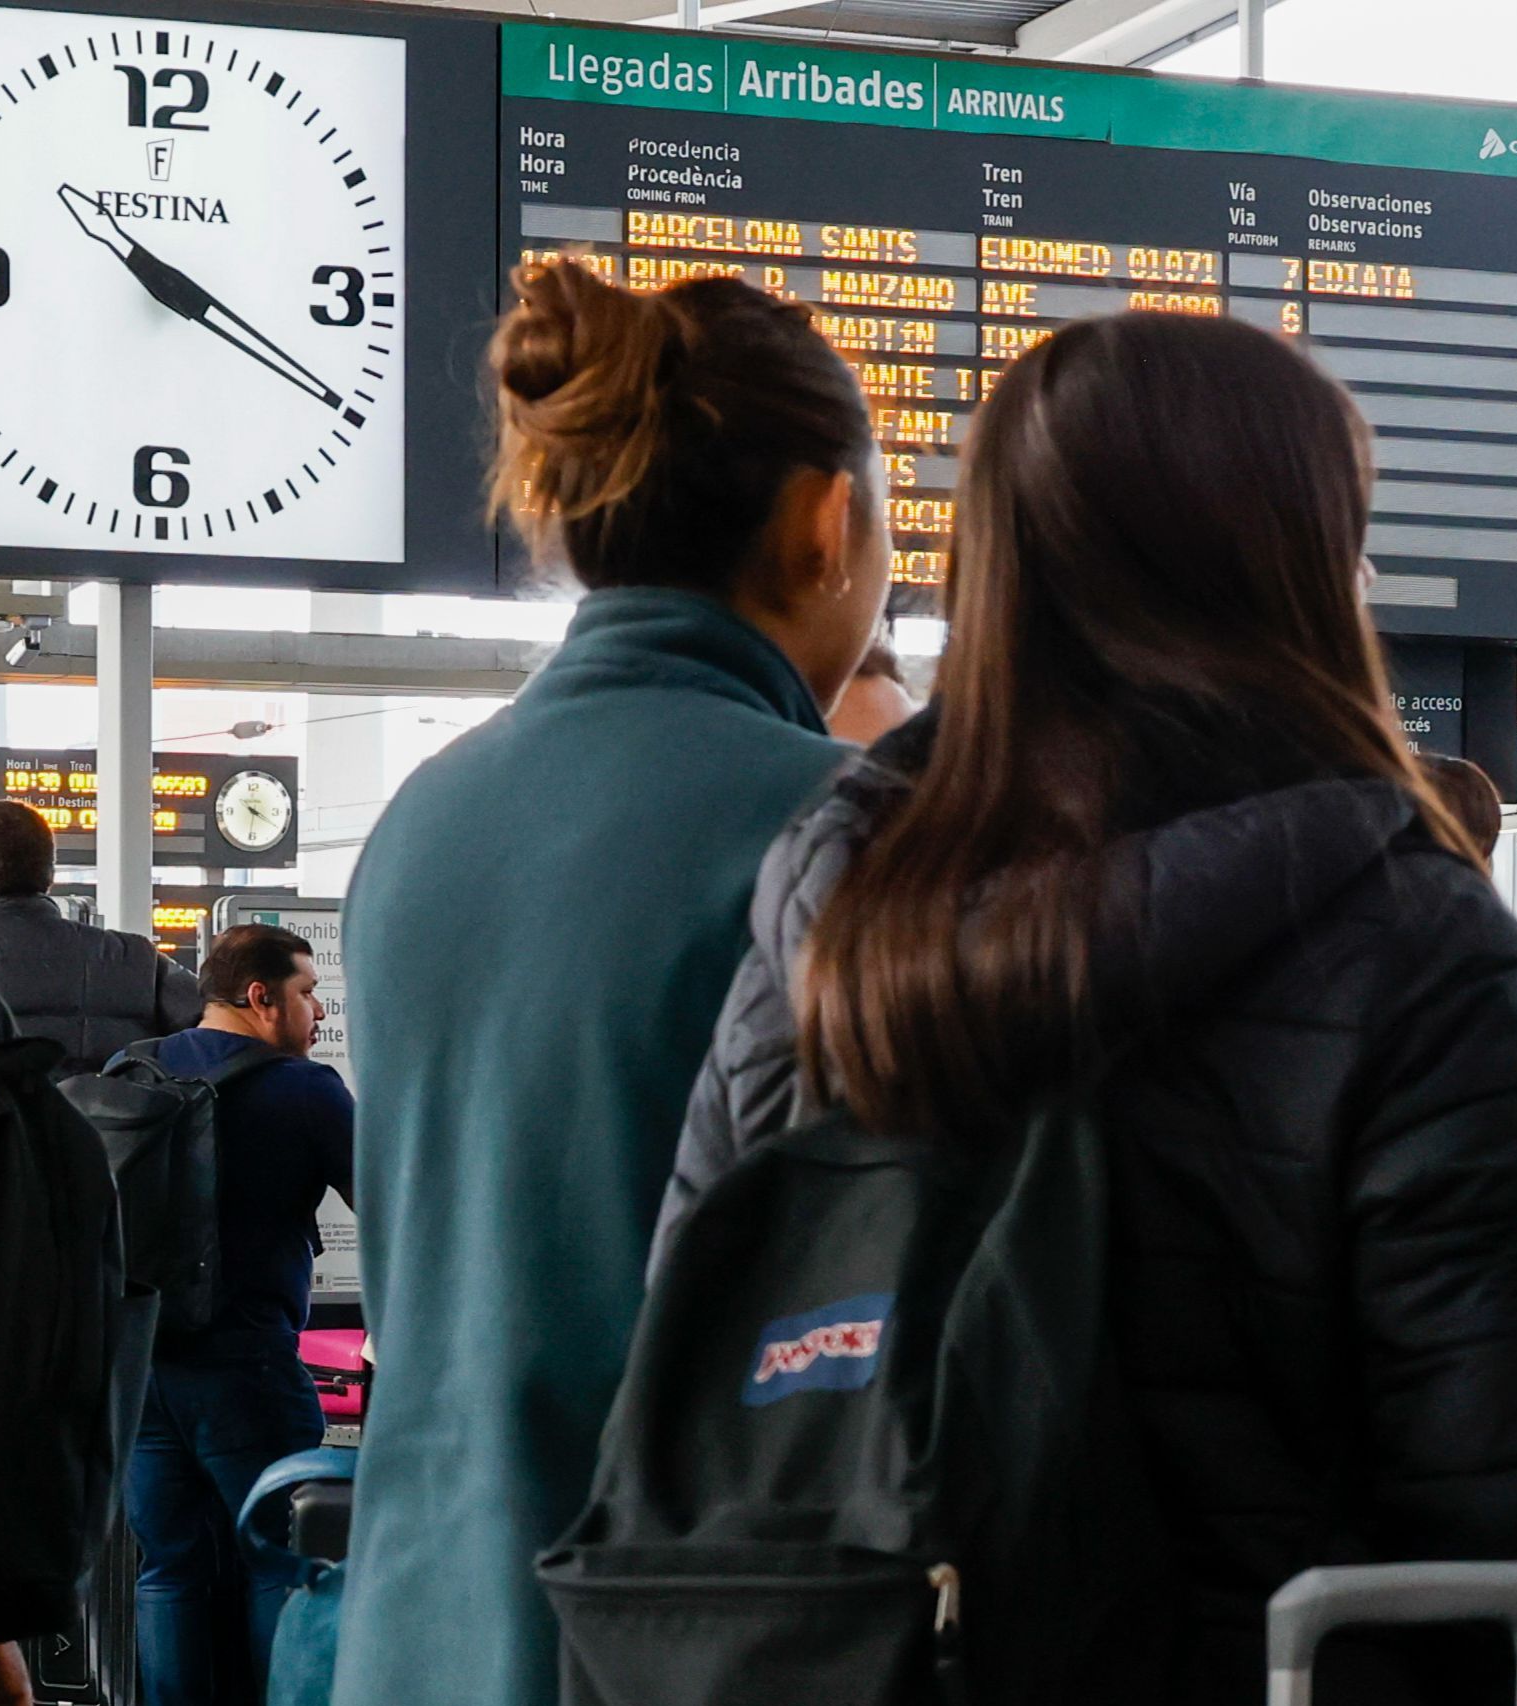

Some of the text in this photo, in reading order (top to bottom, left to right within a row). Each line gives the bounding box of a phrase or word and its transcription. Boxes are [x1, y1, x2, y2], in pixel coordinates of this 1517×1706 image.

[550, 44, 1063, 122] Llegadas Arribades ARRIVALS
[114, 65, 209, 131] 12
[521, 127, 564, 147] Hora
[629, 138, 739, 161] Procedencia
[521, 153, 564, 174] Hora
[983, 163, 1022, 183] Tren
[521, 181, 548, 193] TIME
[628, 165, 741, 194] Procedència
[628, 188, 705, 204] COMING FROM
[983, 189, 1022, 208] Tren
[1229, 183, 1255, 201] Vía
[96, 191, 229, 224] FESTINA
[1309, 189, 1431, 220] Observaciones
[983, 215, 1012, 227] TRAIN
[1230, 208, 1255, 226] Via
[1309, 214, 1422, 238] Observacions
[629, 212, 1111, 276] BARCELONA SANTS EUROMED
[1228, 233, 1278, 246] PLATFORM
[1309, 239, 1356, 252] REMARKS
[310, 265, 364, 326] 3
[133, 446, 190, 508] 6
[1412, 696, 1462, 711] acceso
[6, 760, 31, 769] Hora
[70, 761, 92, 771] Tren
